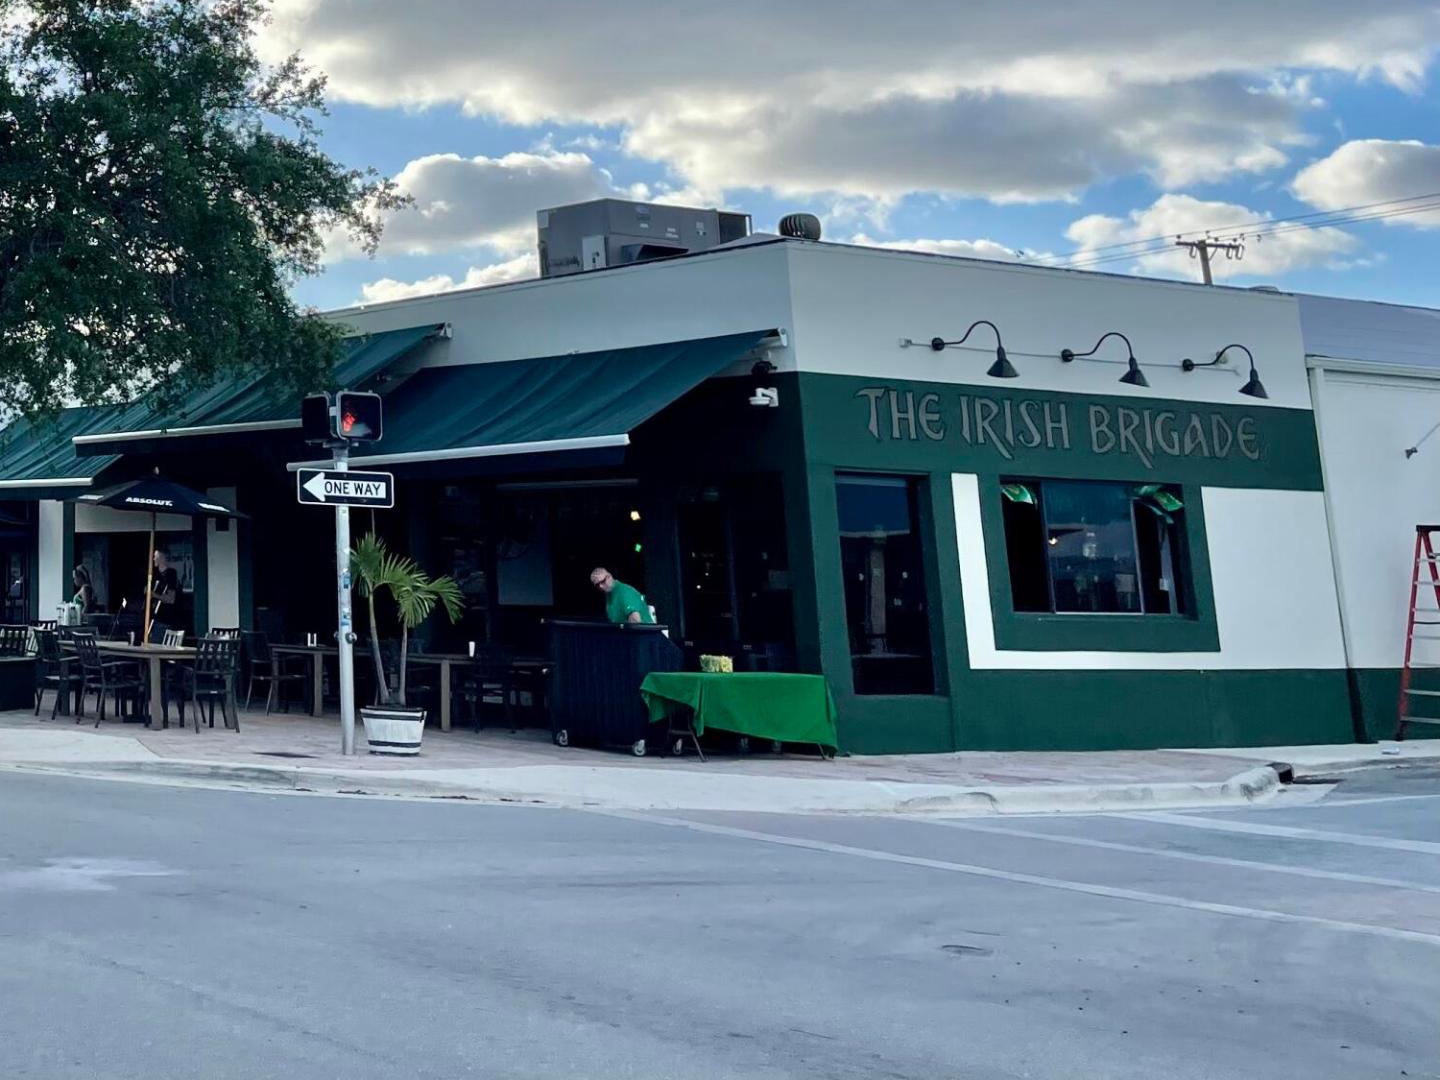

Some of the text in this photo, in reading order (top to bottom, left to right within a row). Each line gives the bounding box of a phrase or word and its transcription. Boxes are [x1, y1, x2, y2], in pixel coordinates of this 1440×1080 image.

[855, 386, 1262, 469] THE IRISH BRIGADE
[324, 481, 381, 496] ONE WAY
